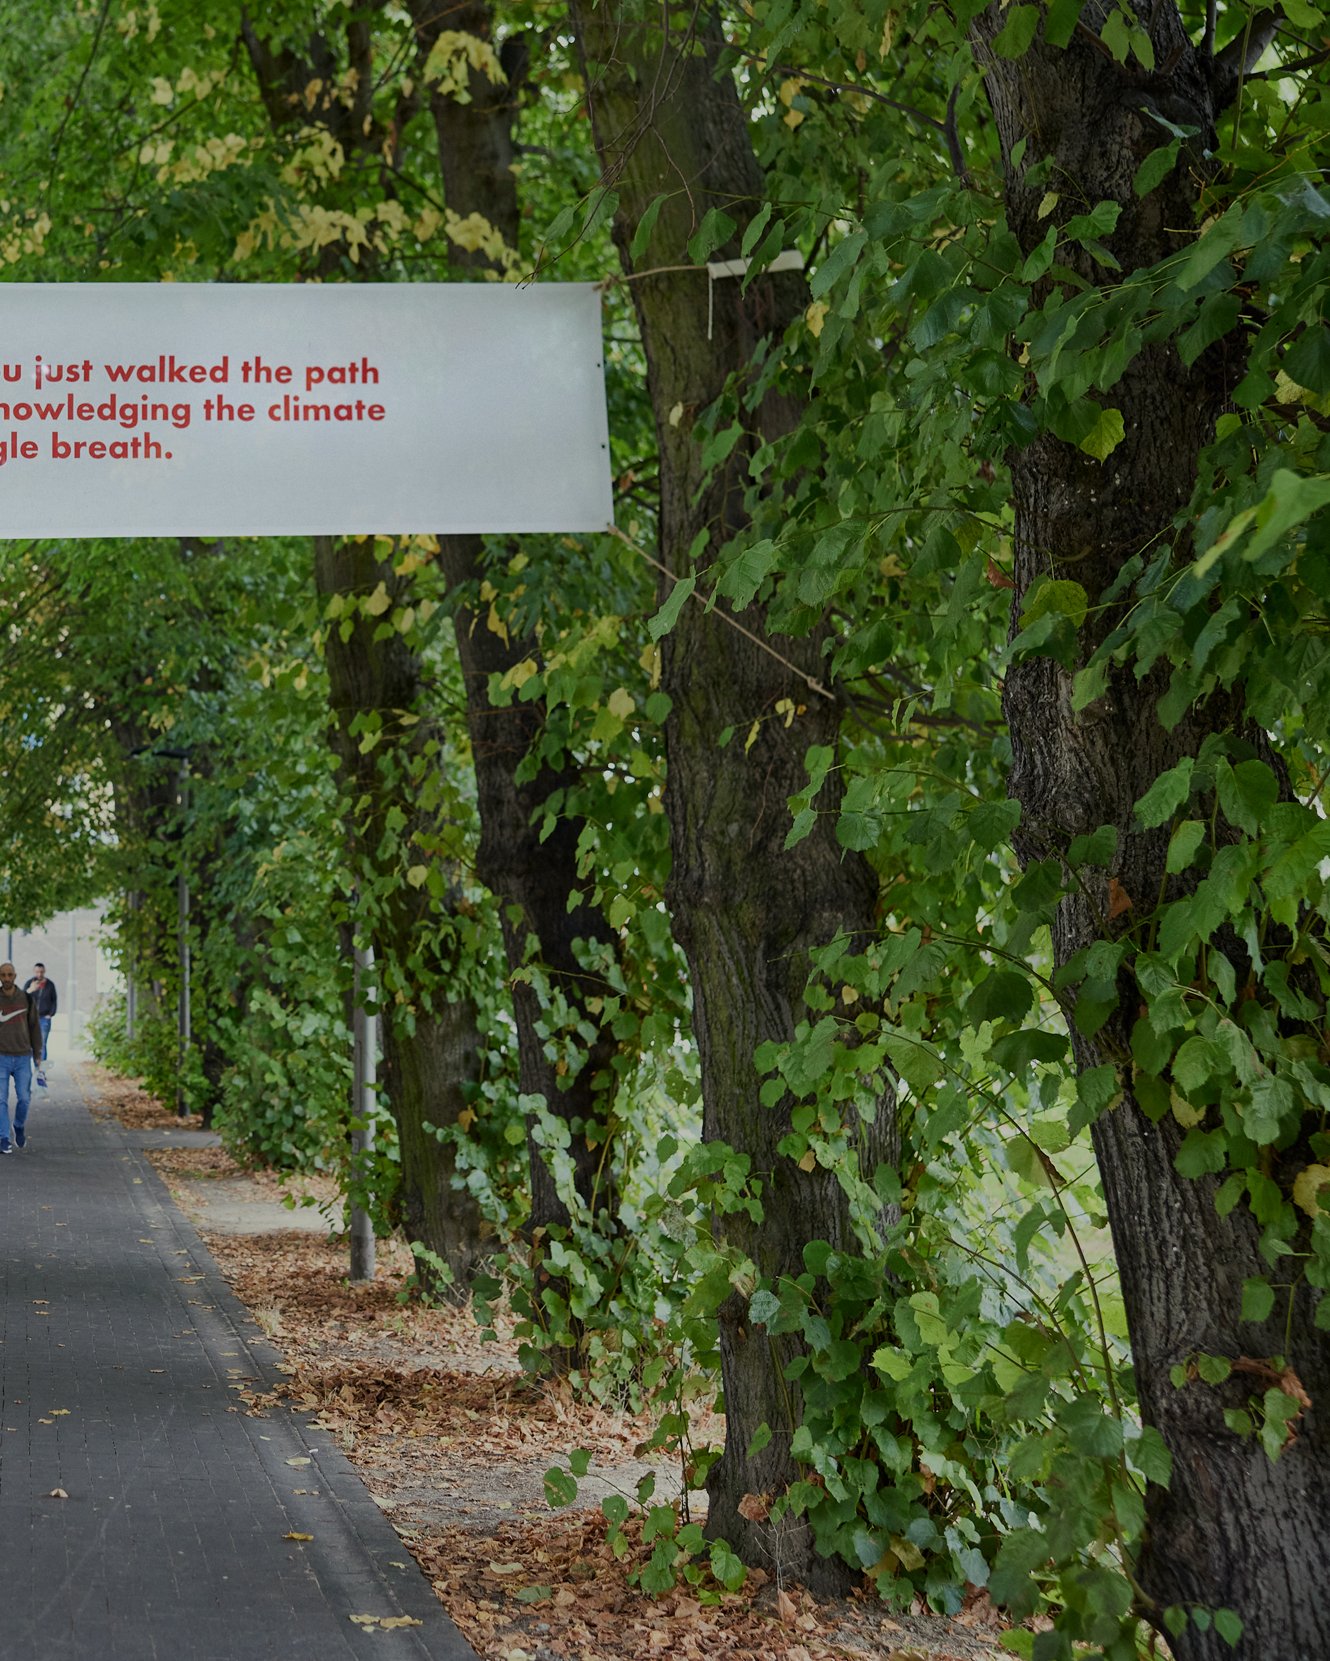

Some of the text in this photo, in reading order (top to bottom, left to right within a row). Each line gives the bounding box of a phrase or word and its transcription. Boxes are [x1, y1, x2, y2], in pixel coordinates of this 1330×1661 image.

[35, 355, 94, 391] just
[104, 355, 229, 384] walked
[241, 356, 293, 385] the
[306, 357, 380, 392] path
[204, 394, 256, 422] the
[268, 394, 386, 422] climate
[52, 432, 173, 460] breath.
